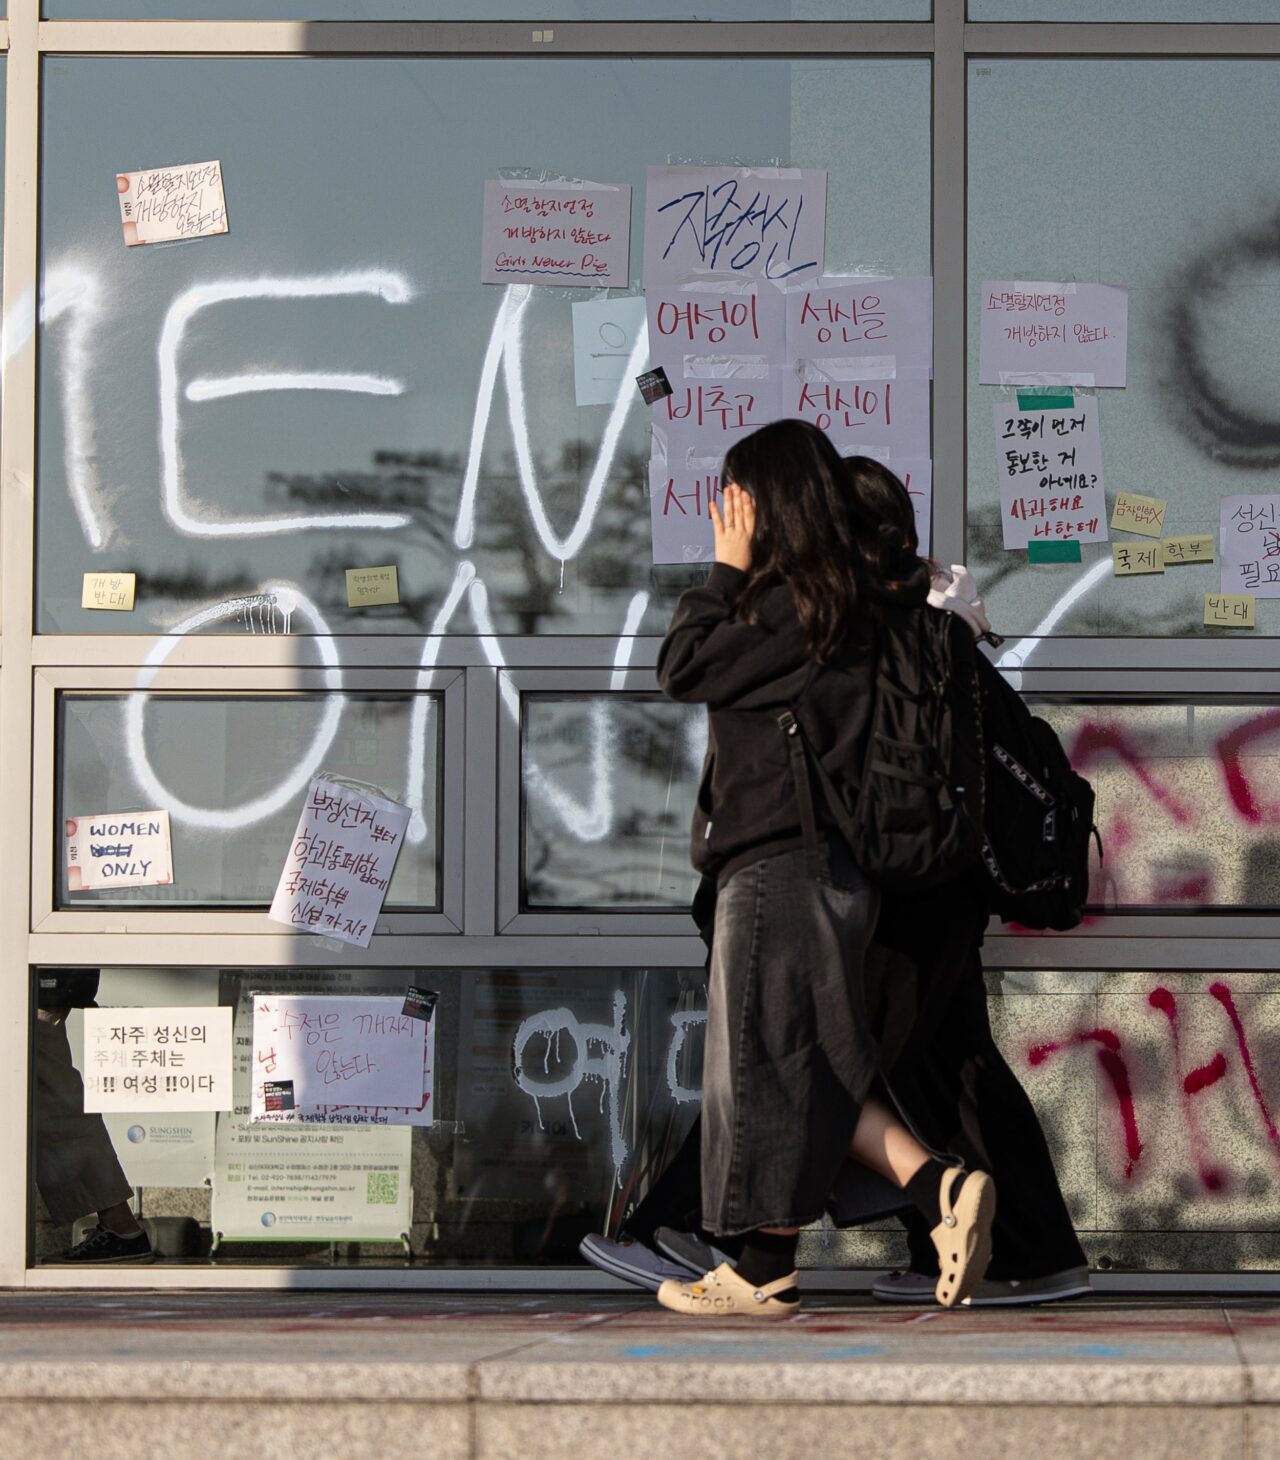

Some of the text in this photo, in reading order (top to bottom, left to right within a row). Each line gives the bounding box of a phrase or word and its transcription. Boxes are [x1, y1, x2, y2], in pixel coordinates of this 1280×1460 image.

[135, 188, 203, 224] 개방하지
[501, 195, 594, 218] 소멸할지언정
[503, 226, 612, 245] 개방하지 않는다
[657, 179, 818, 279] 자주성신
[987, 291, 1065, 316] 소멸할지언정
[657, 292, 888, 343] 여성이 성신을
[1004, 323, 1066, 347] 개방하지
[666, 382, 891, 431] 비추고 성신이
[1002, 414, 1086, 440] 그쪽이 먼저
[1006, 447, 1076, 476] 통보한 거
[1011, 495, 1084, 520] 사과해요
[1117, 543, 1202, 570] 국제 학부
[94, 590, 126, 605] 반대
[1208, 598, 1248, 620] 반대
[308, 787, 397, 845] 부정선거 부터
[90, 822, 160, 836] WOMEN
[101, 860, 152, 877] ONLY
[285, 871, 350, 909] 국제학부
[110, 1026, 206, 1044] 자주 성신의
[281, 1011, 414, 1046] 수정은 깨지지
[131, 1050, 185, 1068] 주체는
[123, 1076, 158, 1093] 여성
[150, 1127, 193, 1139] SUNGSHIN
